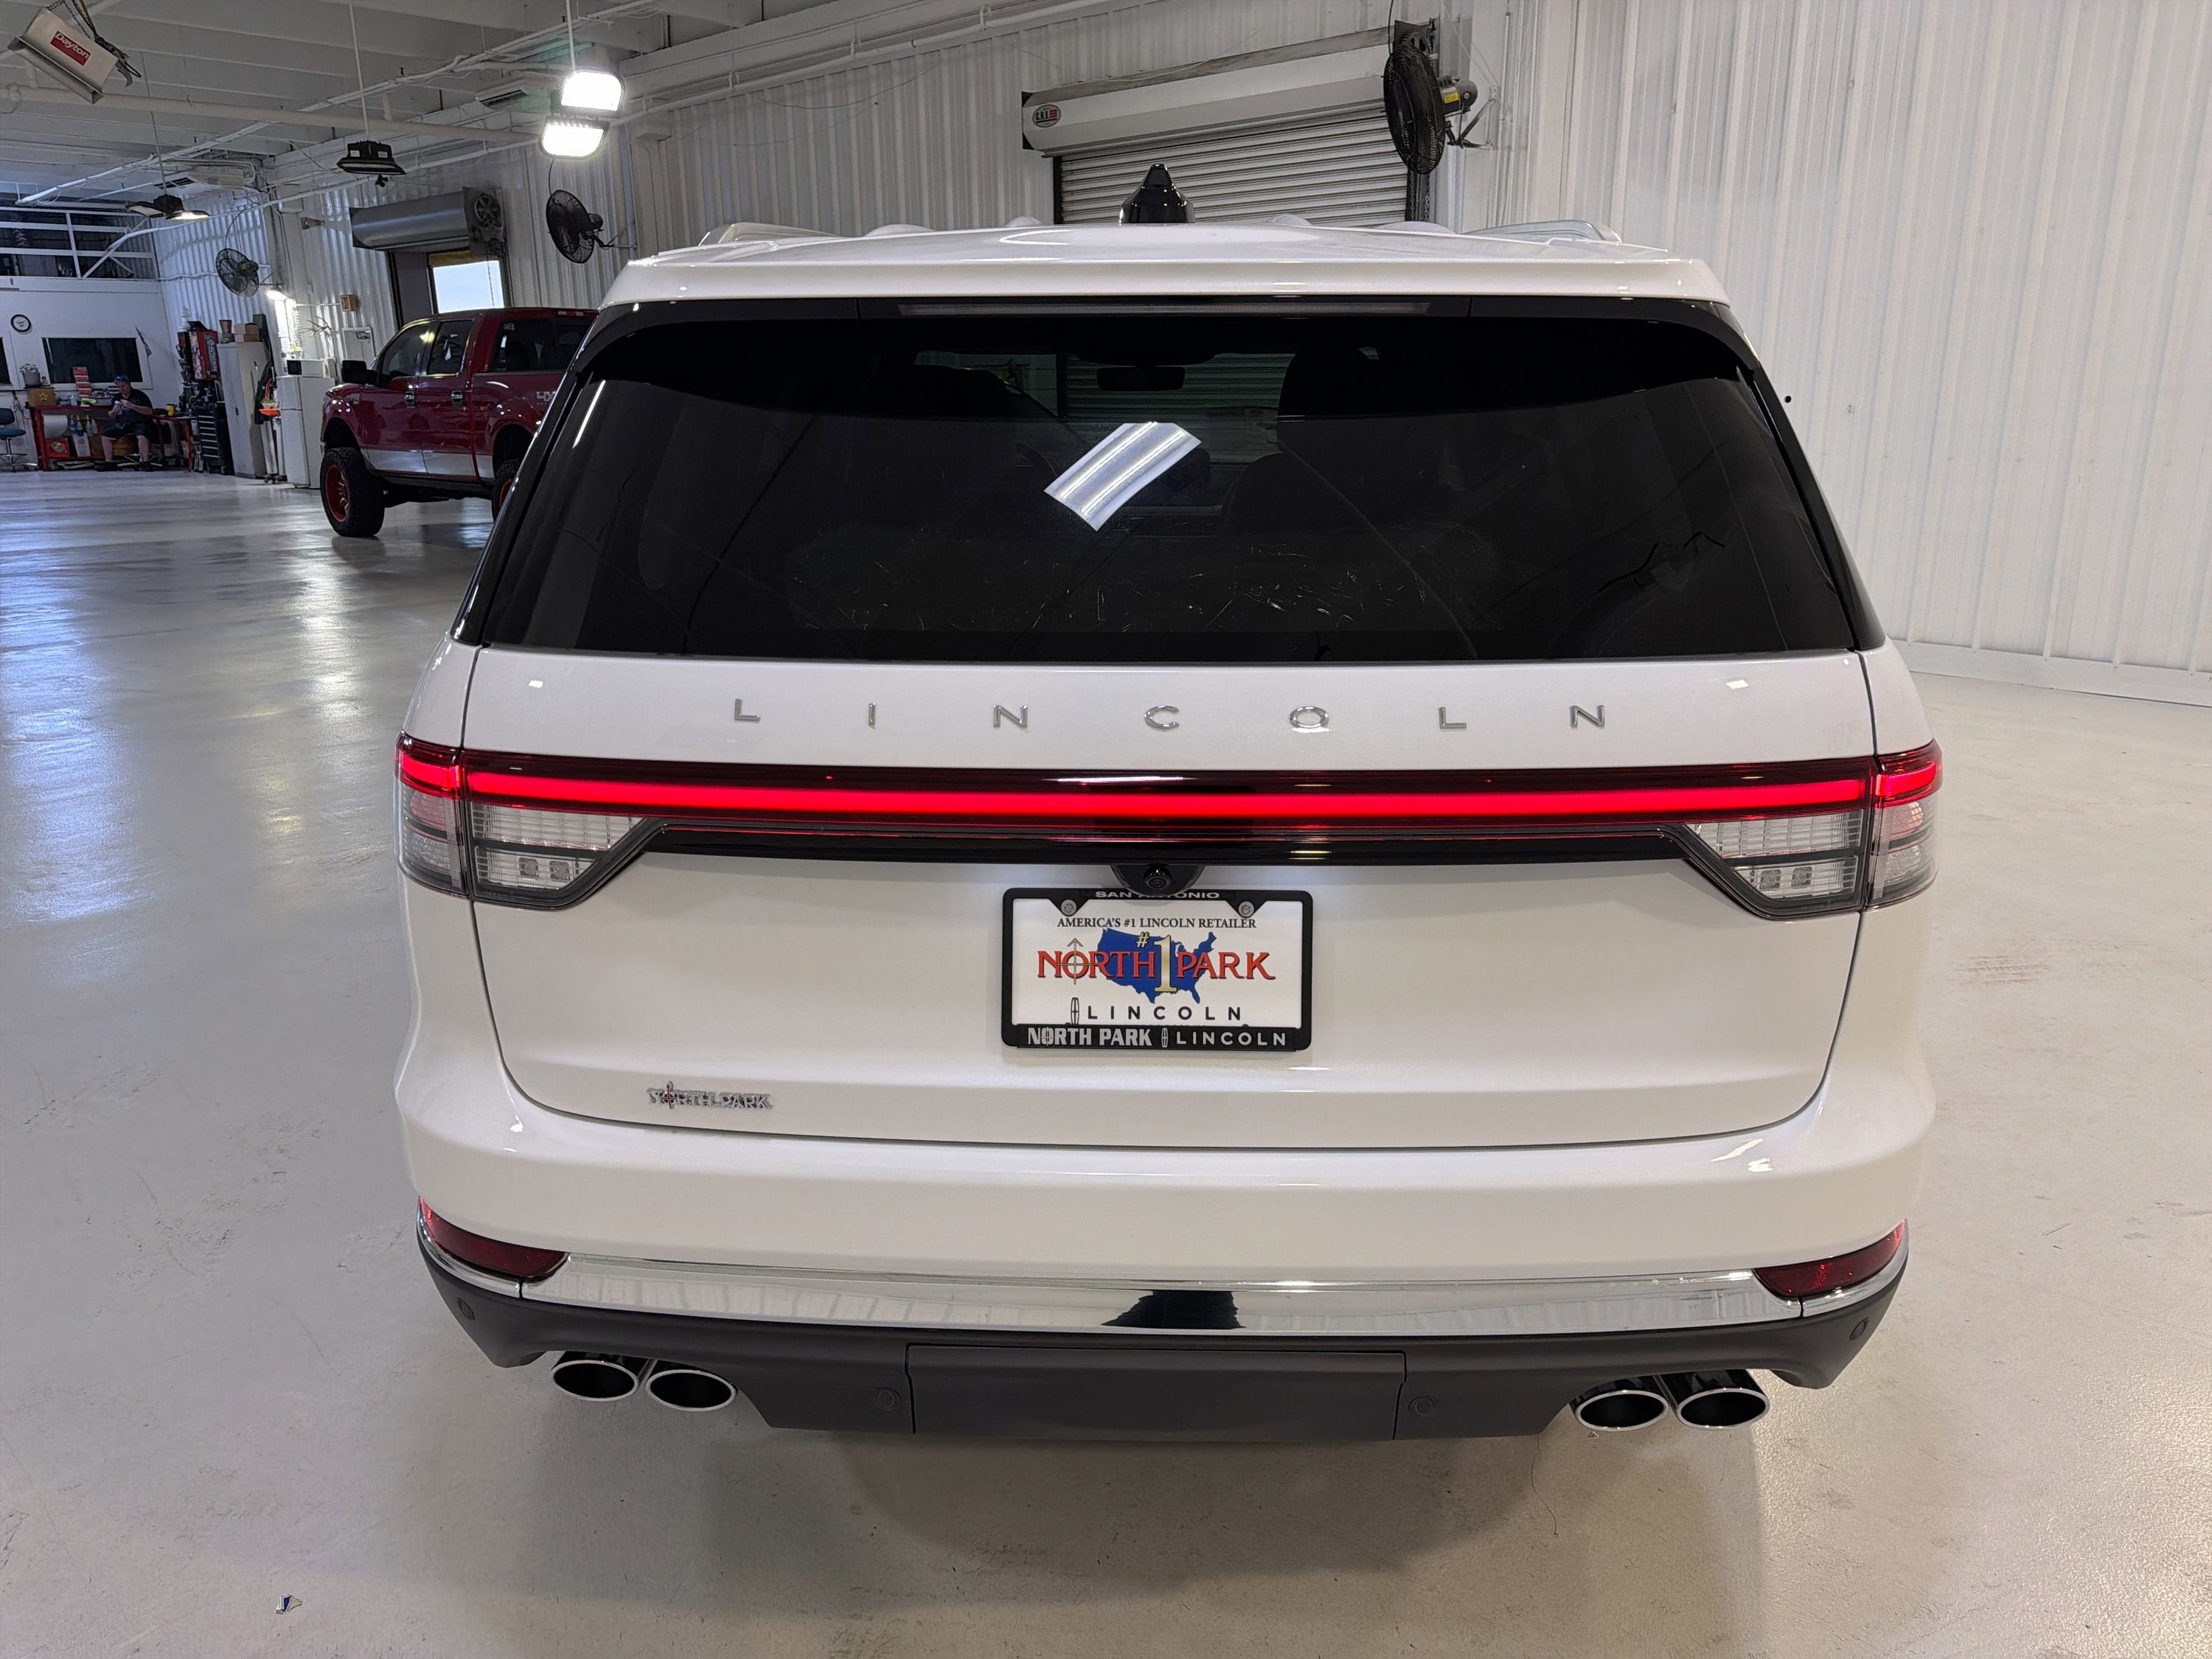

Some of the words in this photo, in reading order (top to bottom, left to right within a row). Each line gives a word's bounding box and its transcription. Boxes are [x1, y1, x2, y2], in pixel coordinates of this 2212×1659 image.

[55, 32, 89, 59] Dayton
[734, 698, 1605, 731] LINCOLN
[1057, 917, 1121, 928] AMERICA'S
[1124, 918, 1136, 928] #1
[1139, 917, 1195, 928] LINCOLN
[1198, 919, 1256, 929] RETAILER
[1037, 950, 1156, 979] NORTH
[1176, 951, 1276, 981] PARK
[1088, 1005, 1241, 1021] LINCOLN
[1027, 1027, 1092, 1046] NORTH
[1099, 1029, 1152, 1046] PARK
[1176, 1031, 1286, 1046] LINCOLN
[648, 1090, 715, 1108] NORTH
[720, 1092, 773, 1110] PARK
